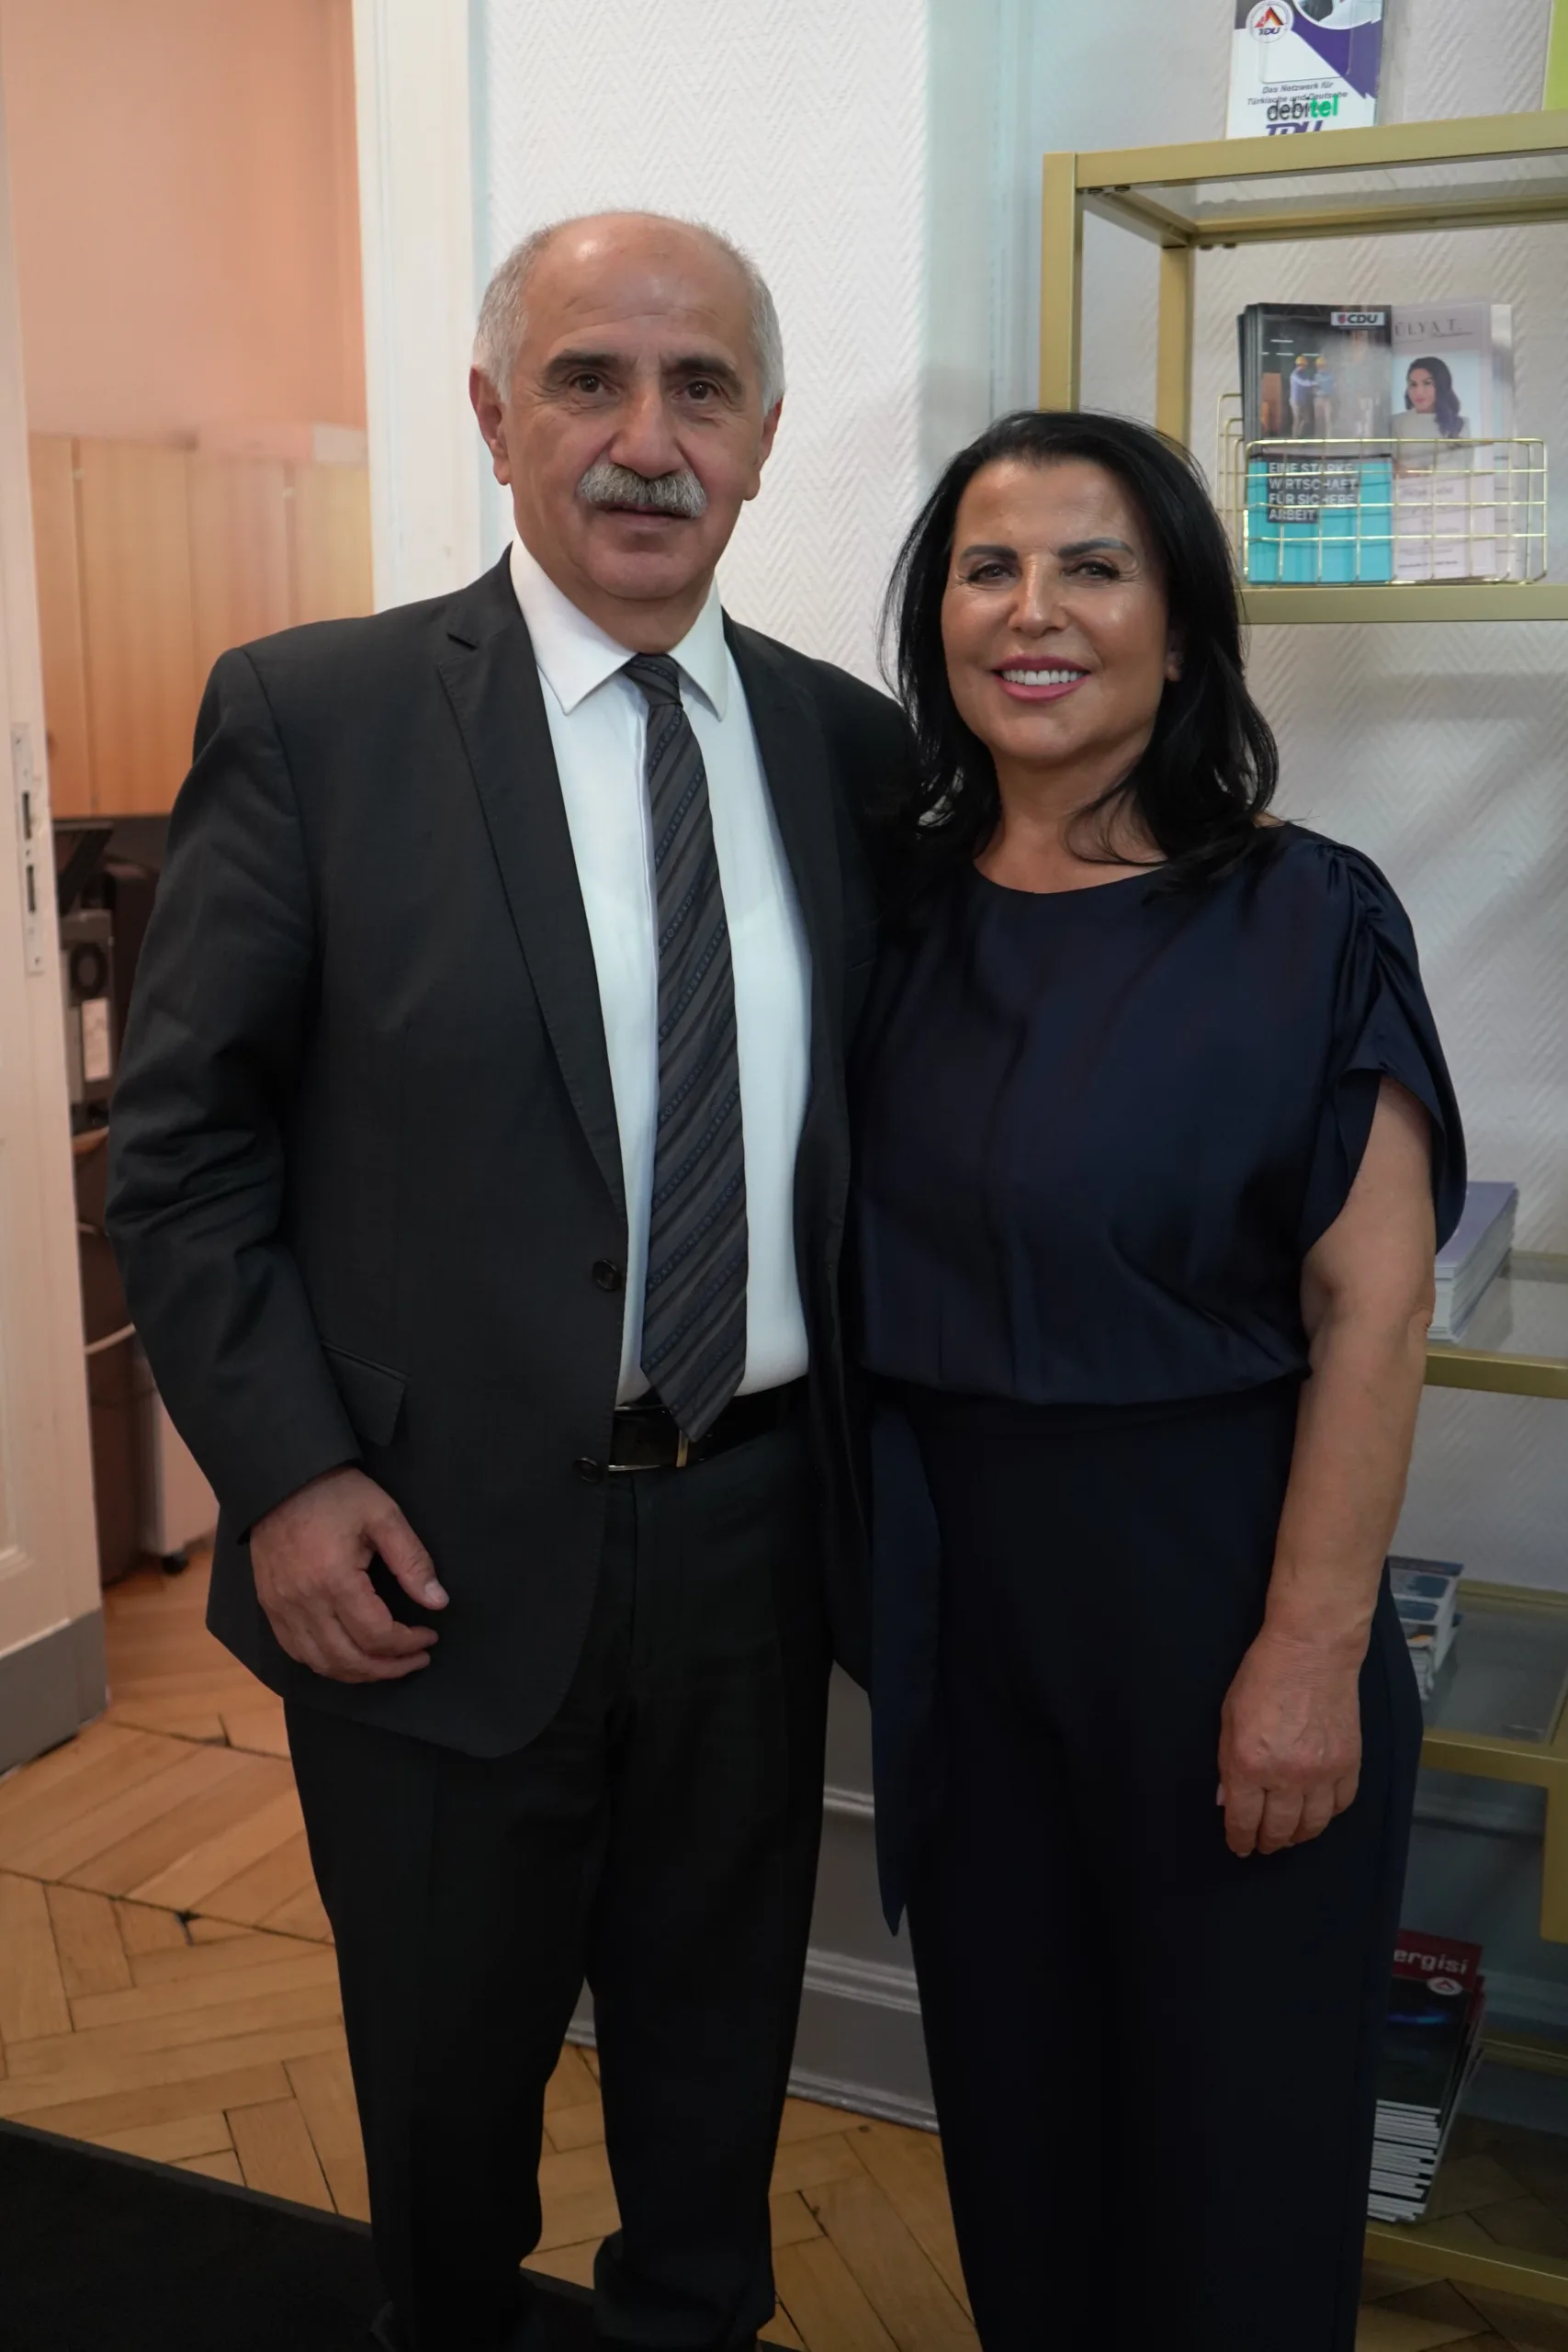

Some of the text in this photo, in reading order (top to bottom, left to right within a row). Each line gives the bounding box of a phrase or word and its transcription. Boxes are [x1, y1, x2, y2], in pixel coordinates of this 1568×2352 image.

[1280, 82, 1319, 93] Netzwerk
[1267, 94, 1341, 121] debitel
[1347, 314, 1378, 324] CDU
[1269, 479, 1358, 490] WRTSCHAFT
